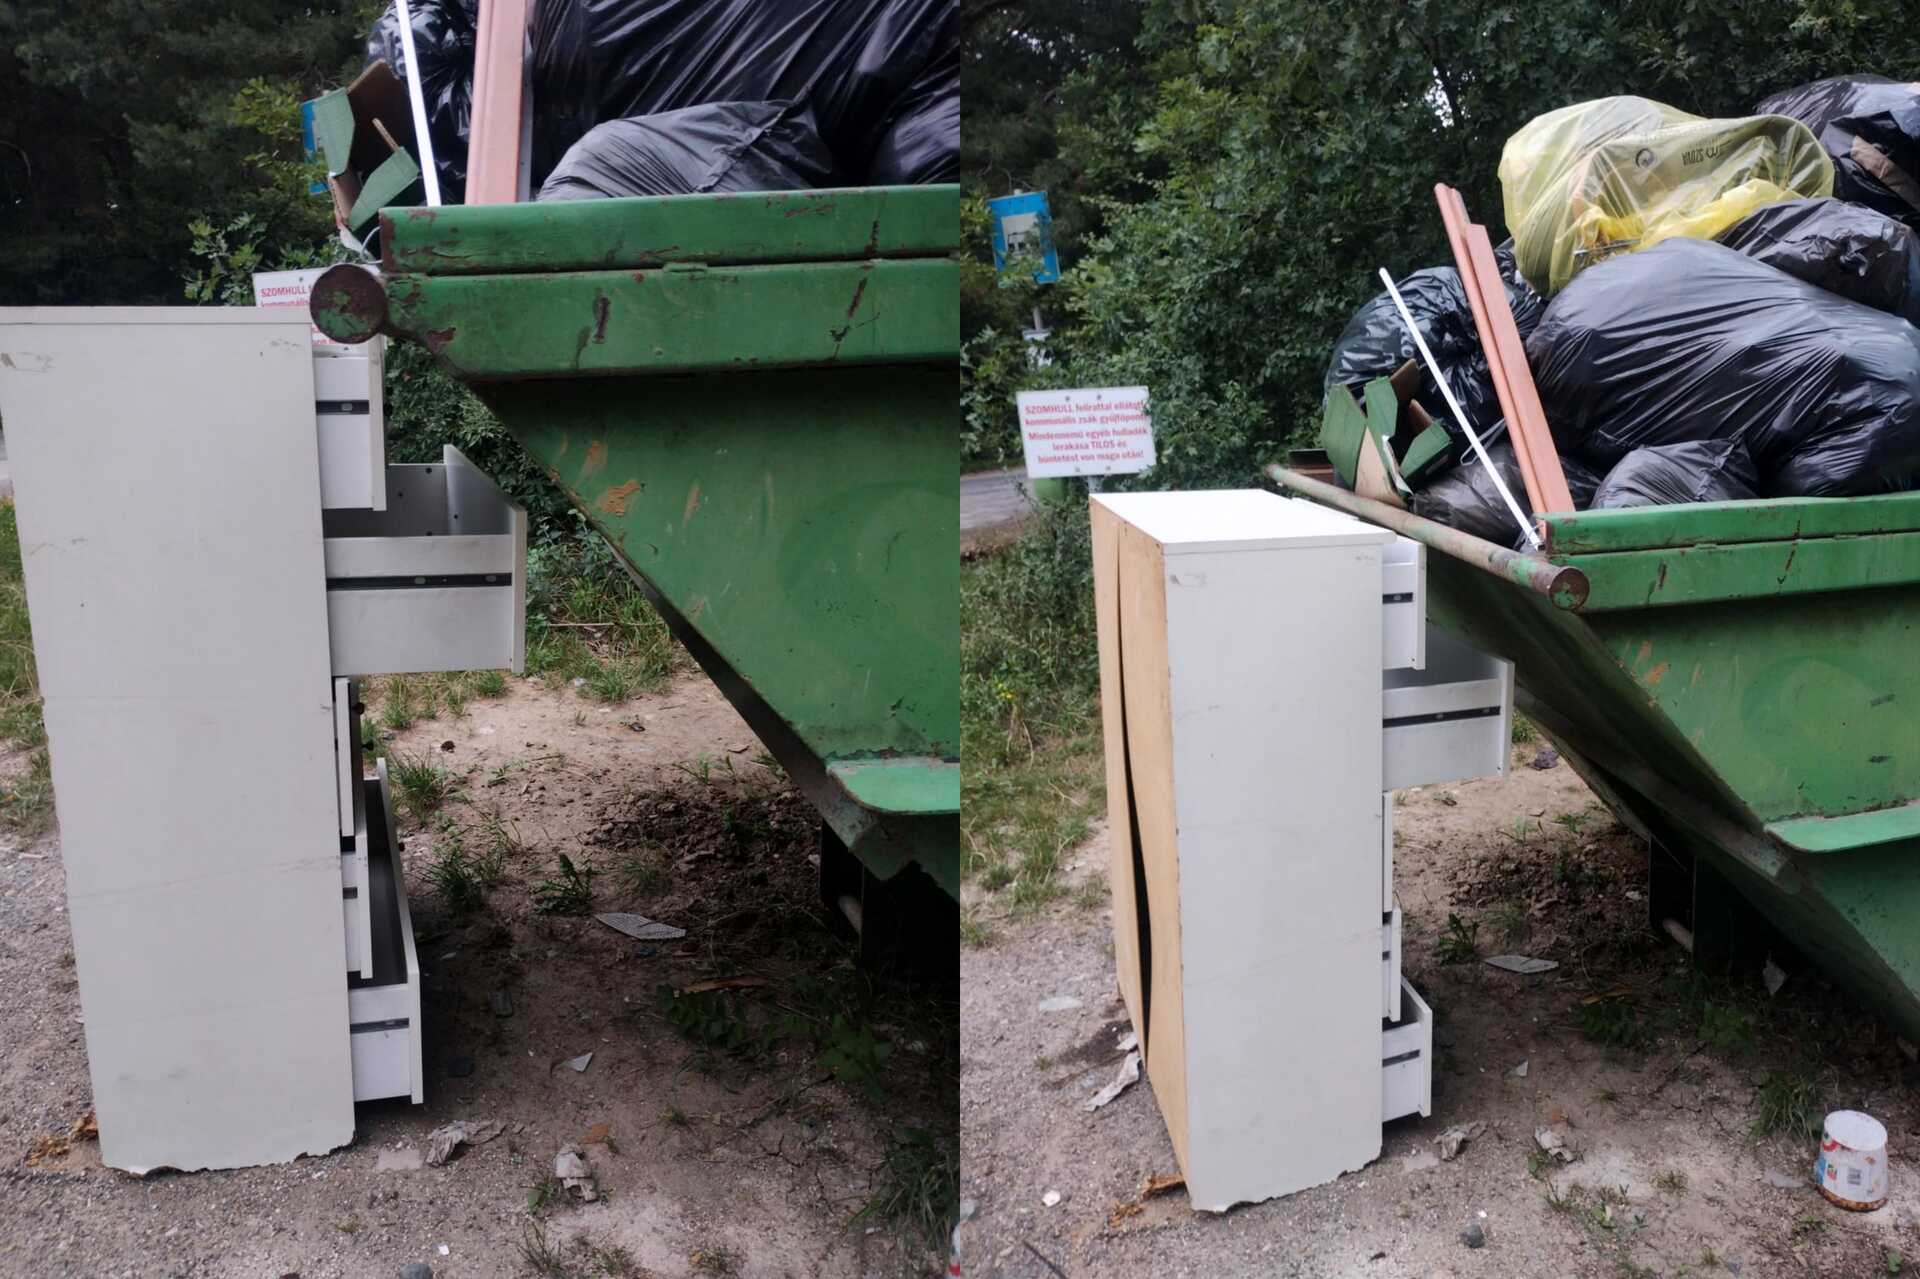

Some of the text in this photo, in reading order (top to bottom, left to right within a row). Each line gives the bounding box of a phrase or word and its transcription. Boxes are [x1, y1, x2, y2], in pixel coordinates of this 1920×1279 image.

[261, 286, 307, 297] SZOMHULL
[1025, 404, 1073, 414] SZOMHULL
[1091, 438, 1115, 449] TILOS
[1097, 453, 1120, 463] maga
